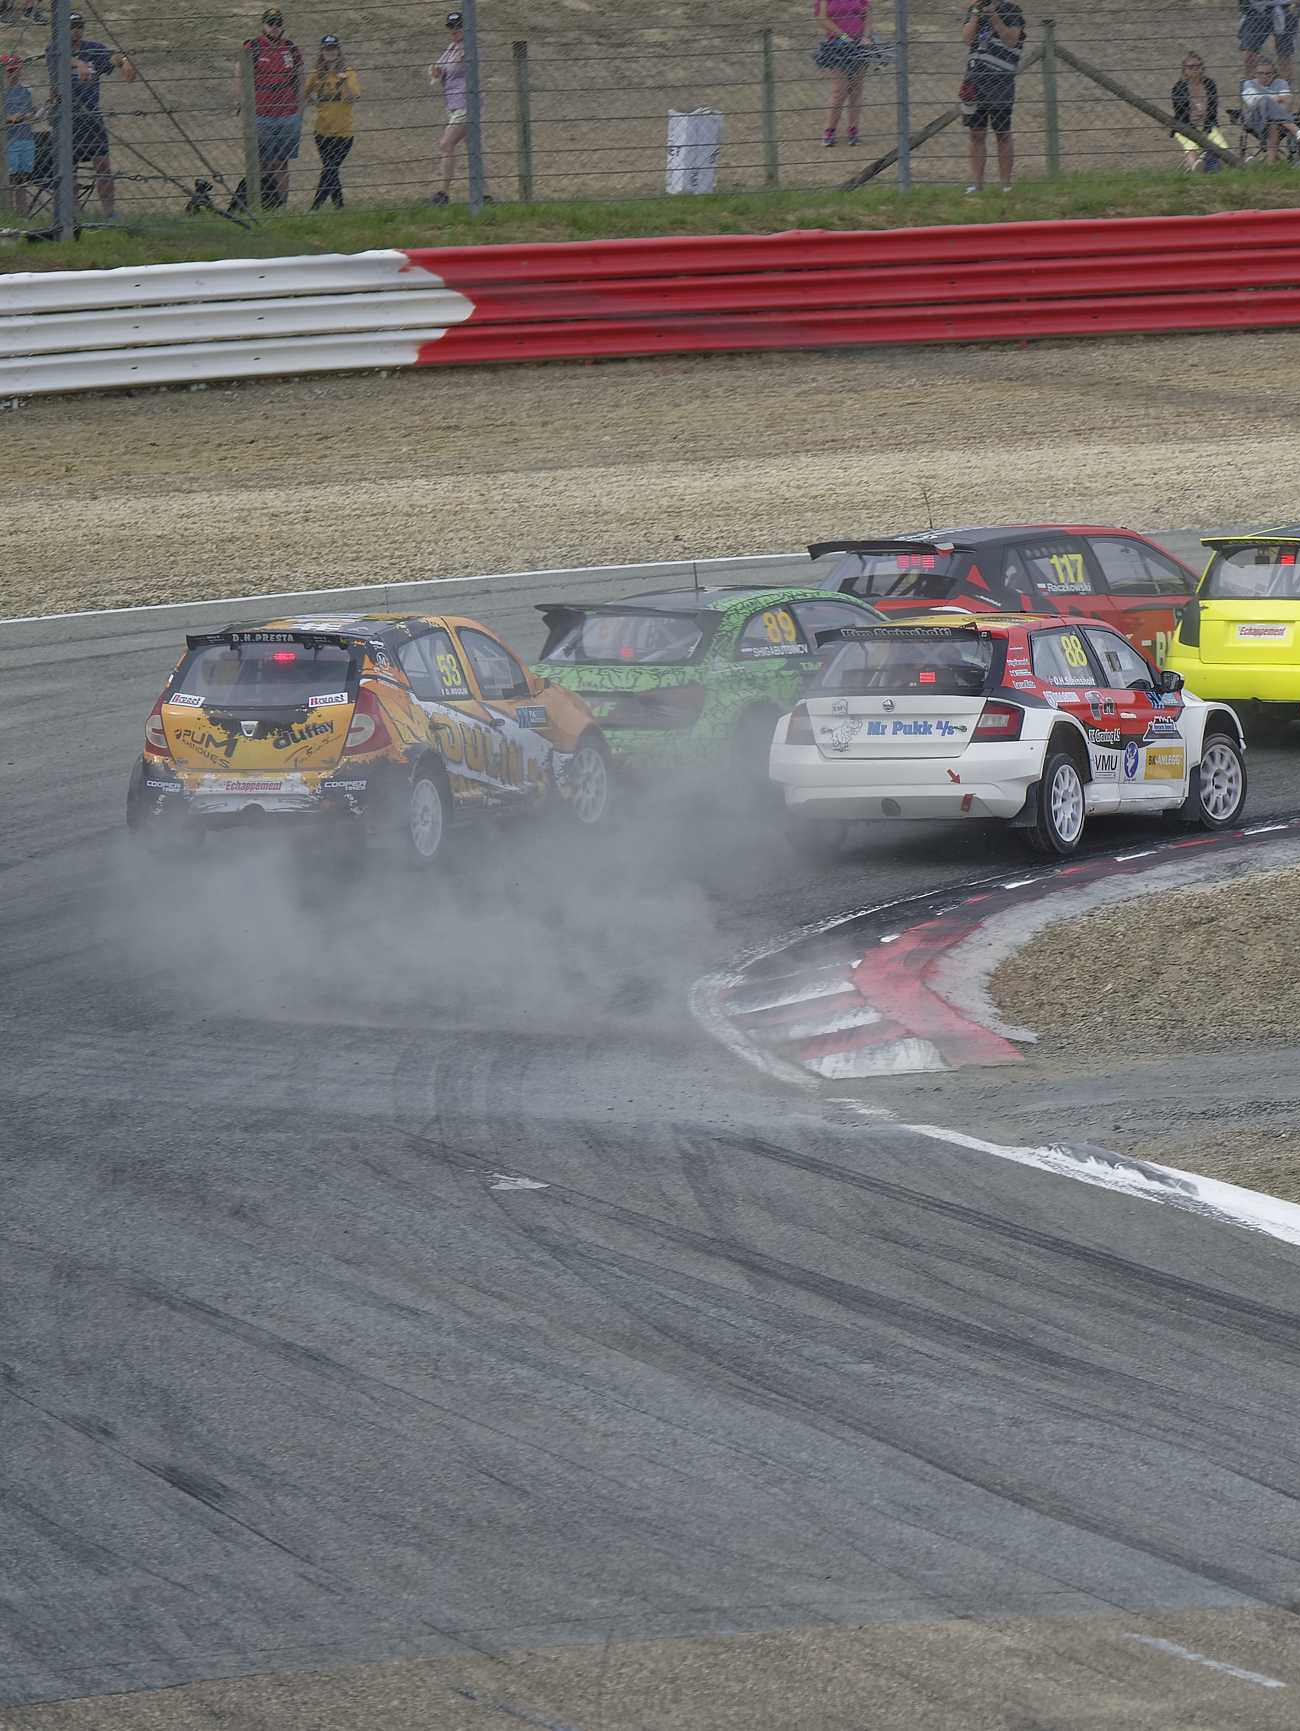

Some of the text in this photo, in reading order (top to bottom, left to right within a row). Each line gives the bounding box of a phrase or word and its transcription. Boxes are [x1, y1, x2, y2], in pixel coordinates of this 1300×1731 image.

[1051, 553, 1085, 584] 117
[762, 611, 797, 643] 89
[1060, 634, 1088, 667] 88
[437, 654, 463, 687] 53
[1095, 755, 1118, 770] VMU
[224, 780, 283, 793] Echappement
